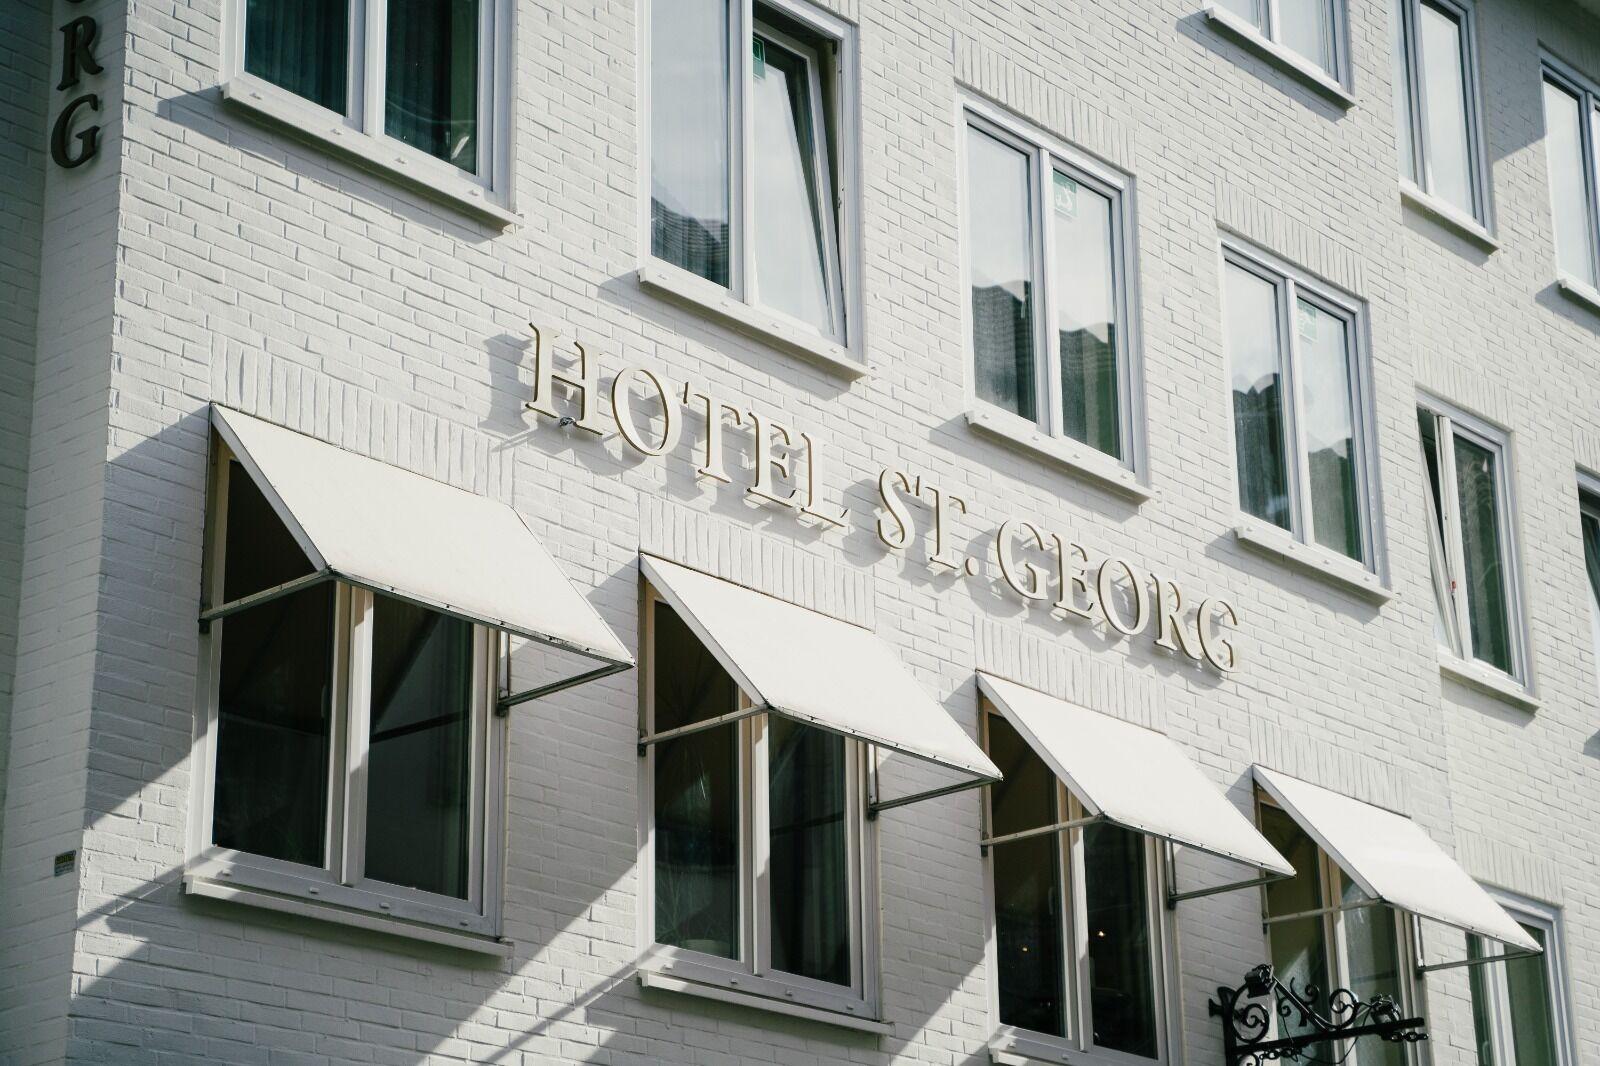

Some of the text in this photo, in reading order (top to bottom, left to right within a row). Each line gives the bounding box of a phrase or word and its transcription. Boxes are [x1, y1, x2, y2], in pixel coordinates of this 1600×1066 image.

[51, 0, 104, 169] RG
[525, 322, 1239, 673] HOTEL ST. GEORG
